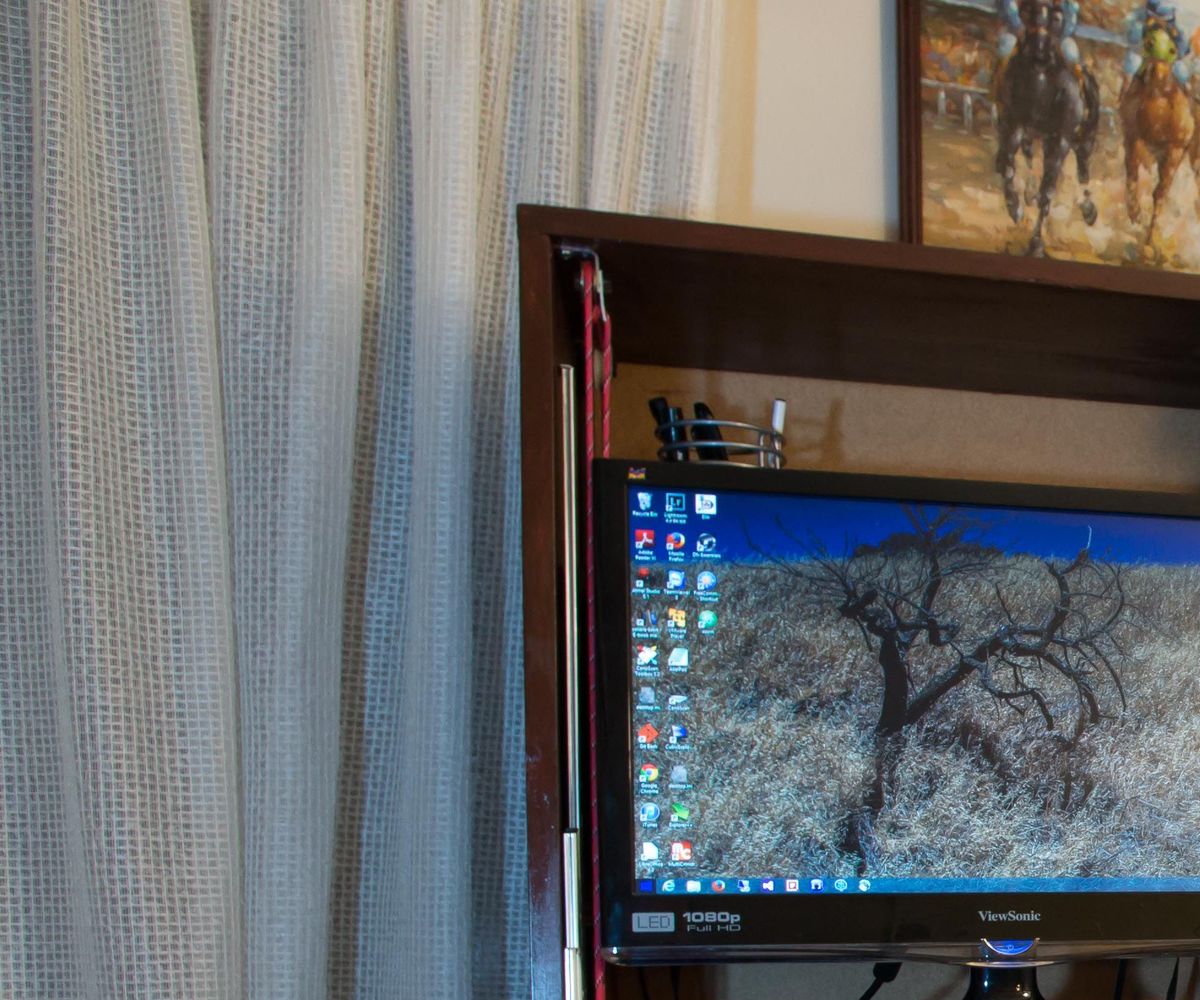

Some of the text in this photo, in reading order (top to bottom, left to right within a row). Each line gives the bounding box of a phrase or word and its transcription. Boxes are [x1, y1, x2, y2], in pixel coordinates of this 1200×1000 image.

[683, 912, 741, 925] 1080p
[978, 910, 1041, 921] ViewSonic
[637, 915, 670, 929] LED
[687, 924, 712, 932] Full
